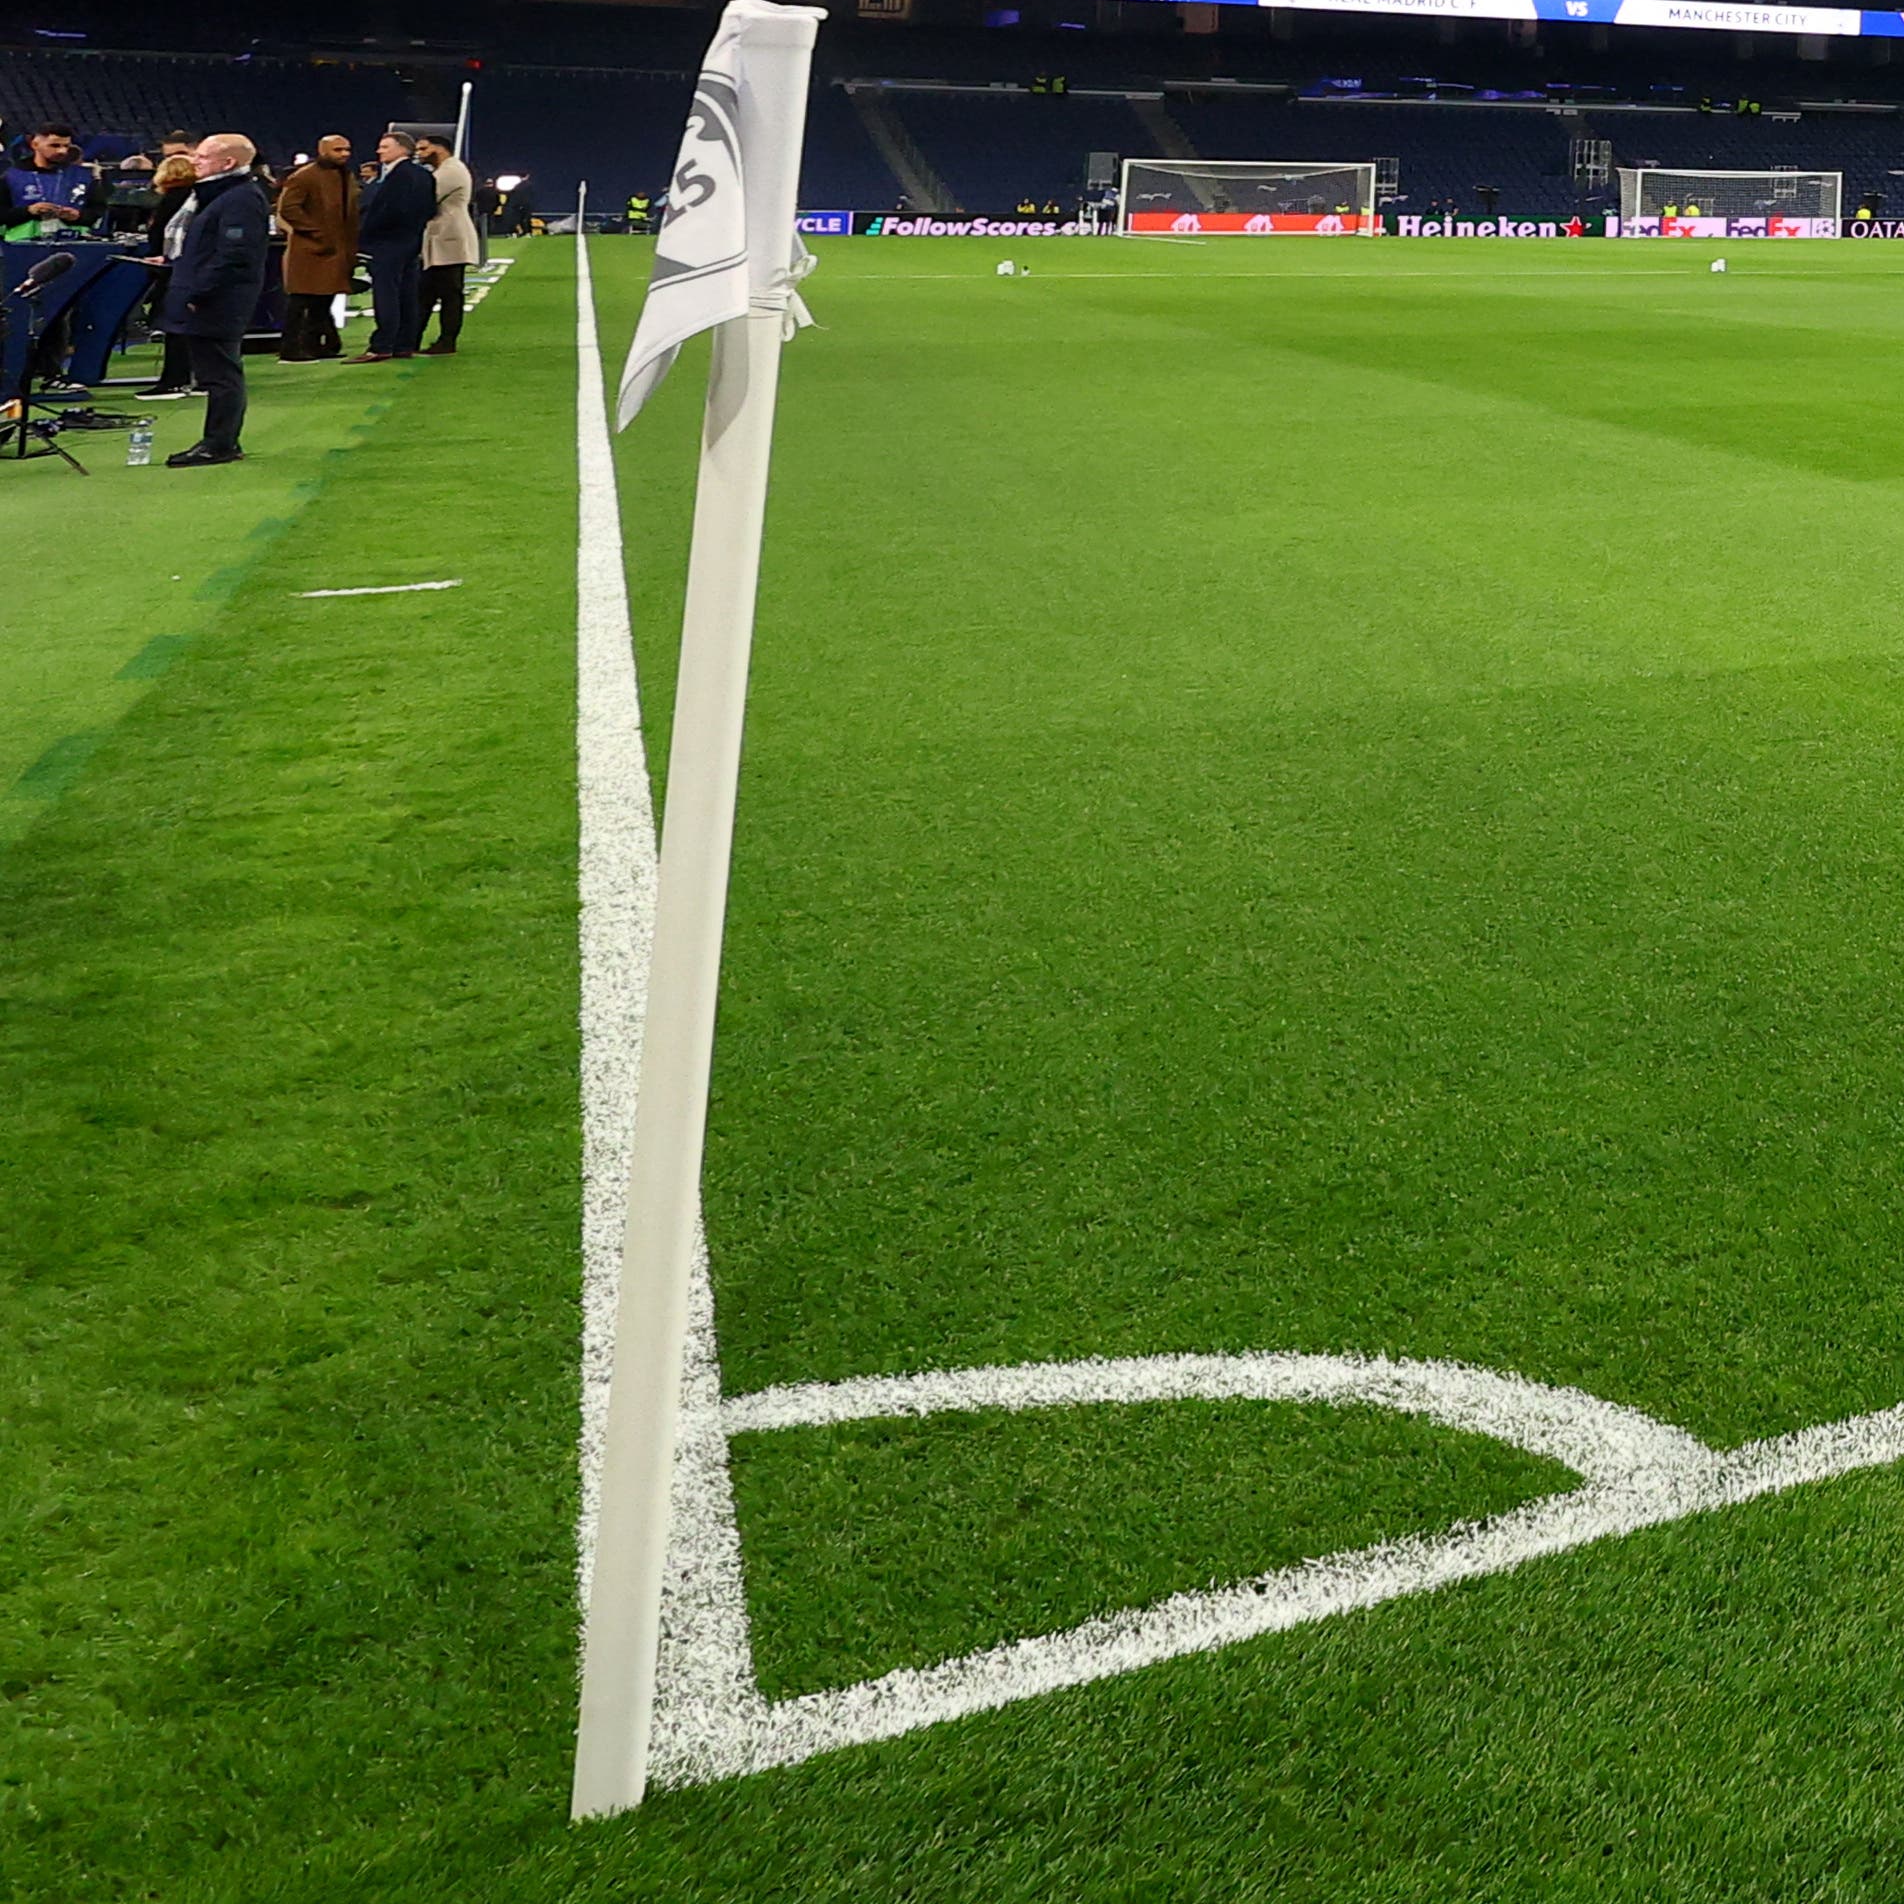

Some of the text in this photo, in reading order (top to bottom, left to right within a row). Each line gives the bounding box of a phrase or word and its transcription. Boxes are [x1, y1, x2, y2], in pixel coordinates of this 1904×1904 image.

[1565, 0, 1589, 17] VS
[1668, 8, 1807, 27] MANCHESTER CITY
[1397, 215, 1557, 238] Heineken
